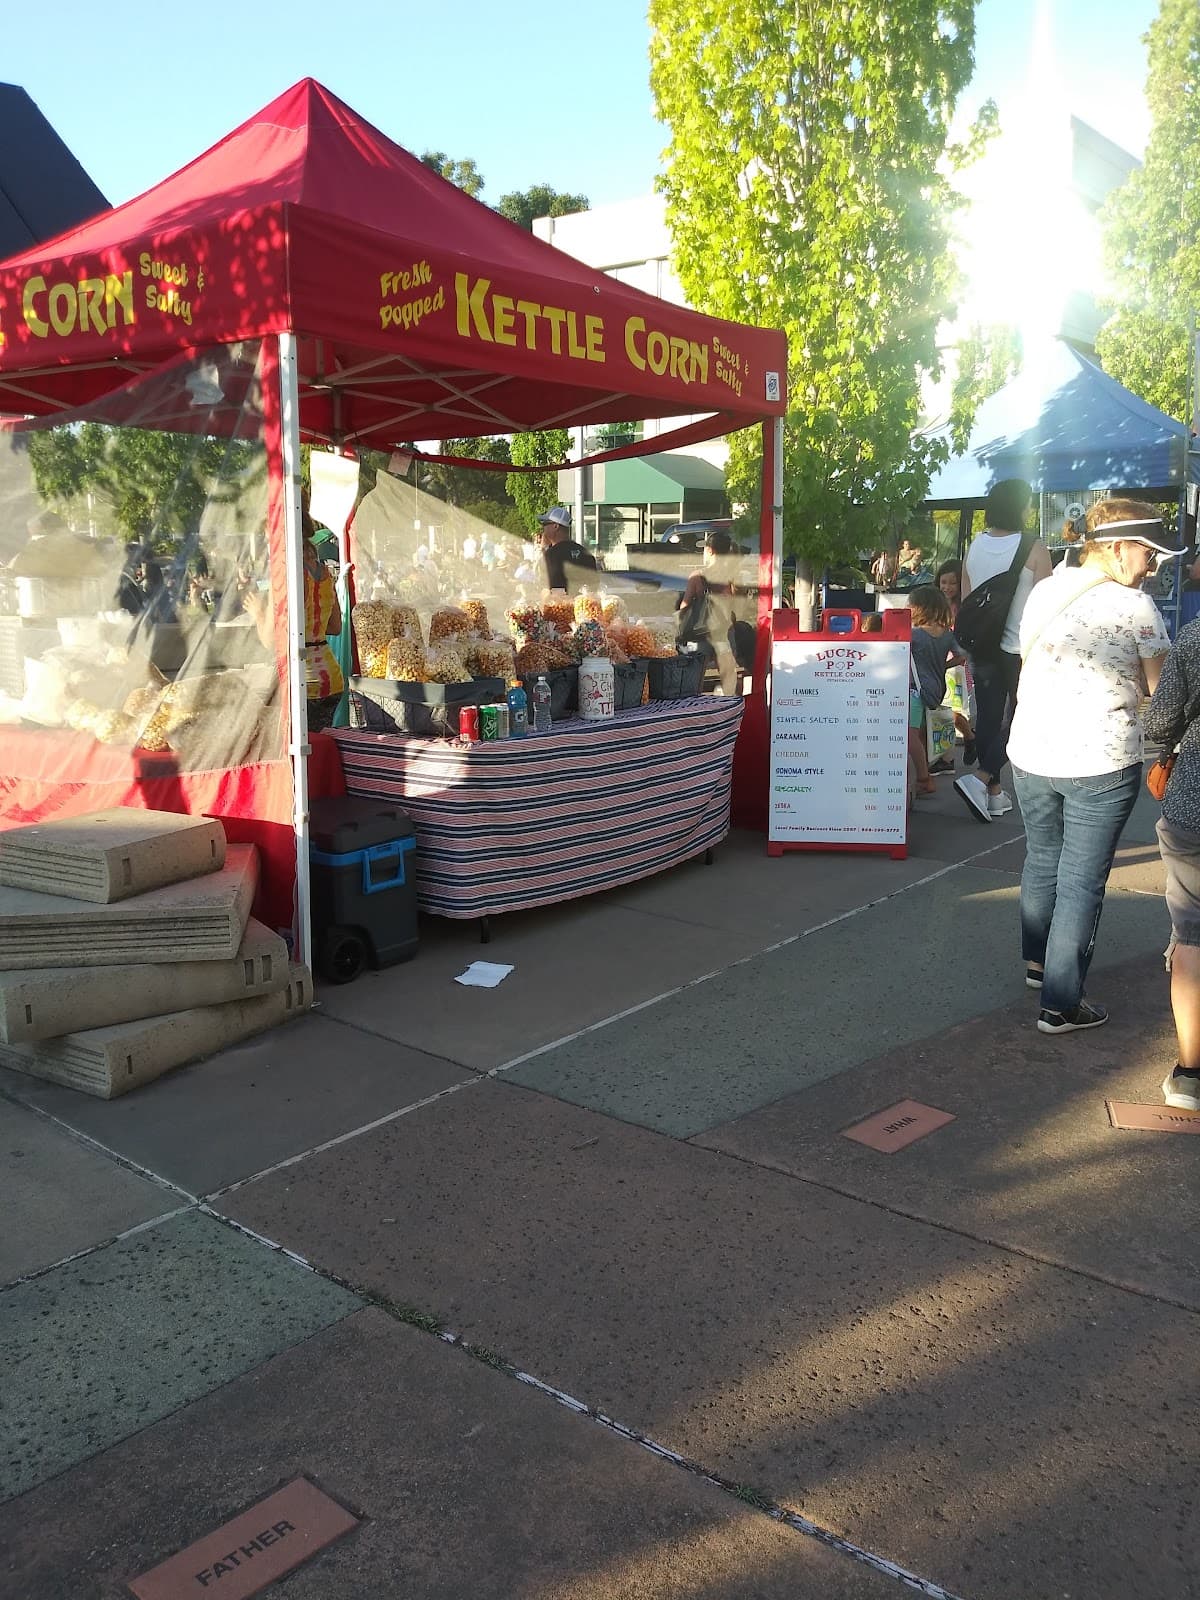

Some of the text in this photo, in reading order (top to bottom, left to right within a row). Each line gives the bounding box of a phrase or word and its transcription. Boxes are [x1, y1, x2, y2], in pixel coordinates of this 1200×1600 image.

[139, 252, 189, 287] Sweet
[380, 259, 433, 298] Fresh
[22, 270, 135, 338] CORN
[145, 284, 192, 325] Salty
[379, 286, 445, 330] Popped
[454, 272, 709, 385] KETTLE CORN
[712, 336, 741, 371] Sweet
[715, 361, 743, 397] Salty
[816, 648, 868, 661] LUCKY
[776, 716, 840, 724] SIMPLE SALTED
[775, 767, 802, 775] SONOMA
[882, 1116, 918, 1134] WHAT
[195, 1520, 296, 1587] FATHER
